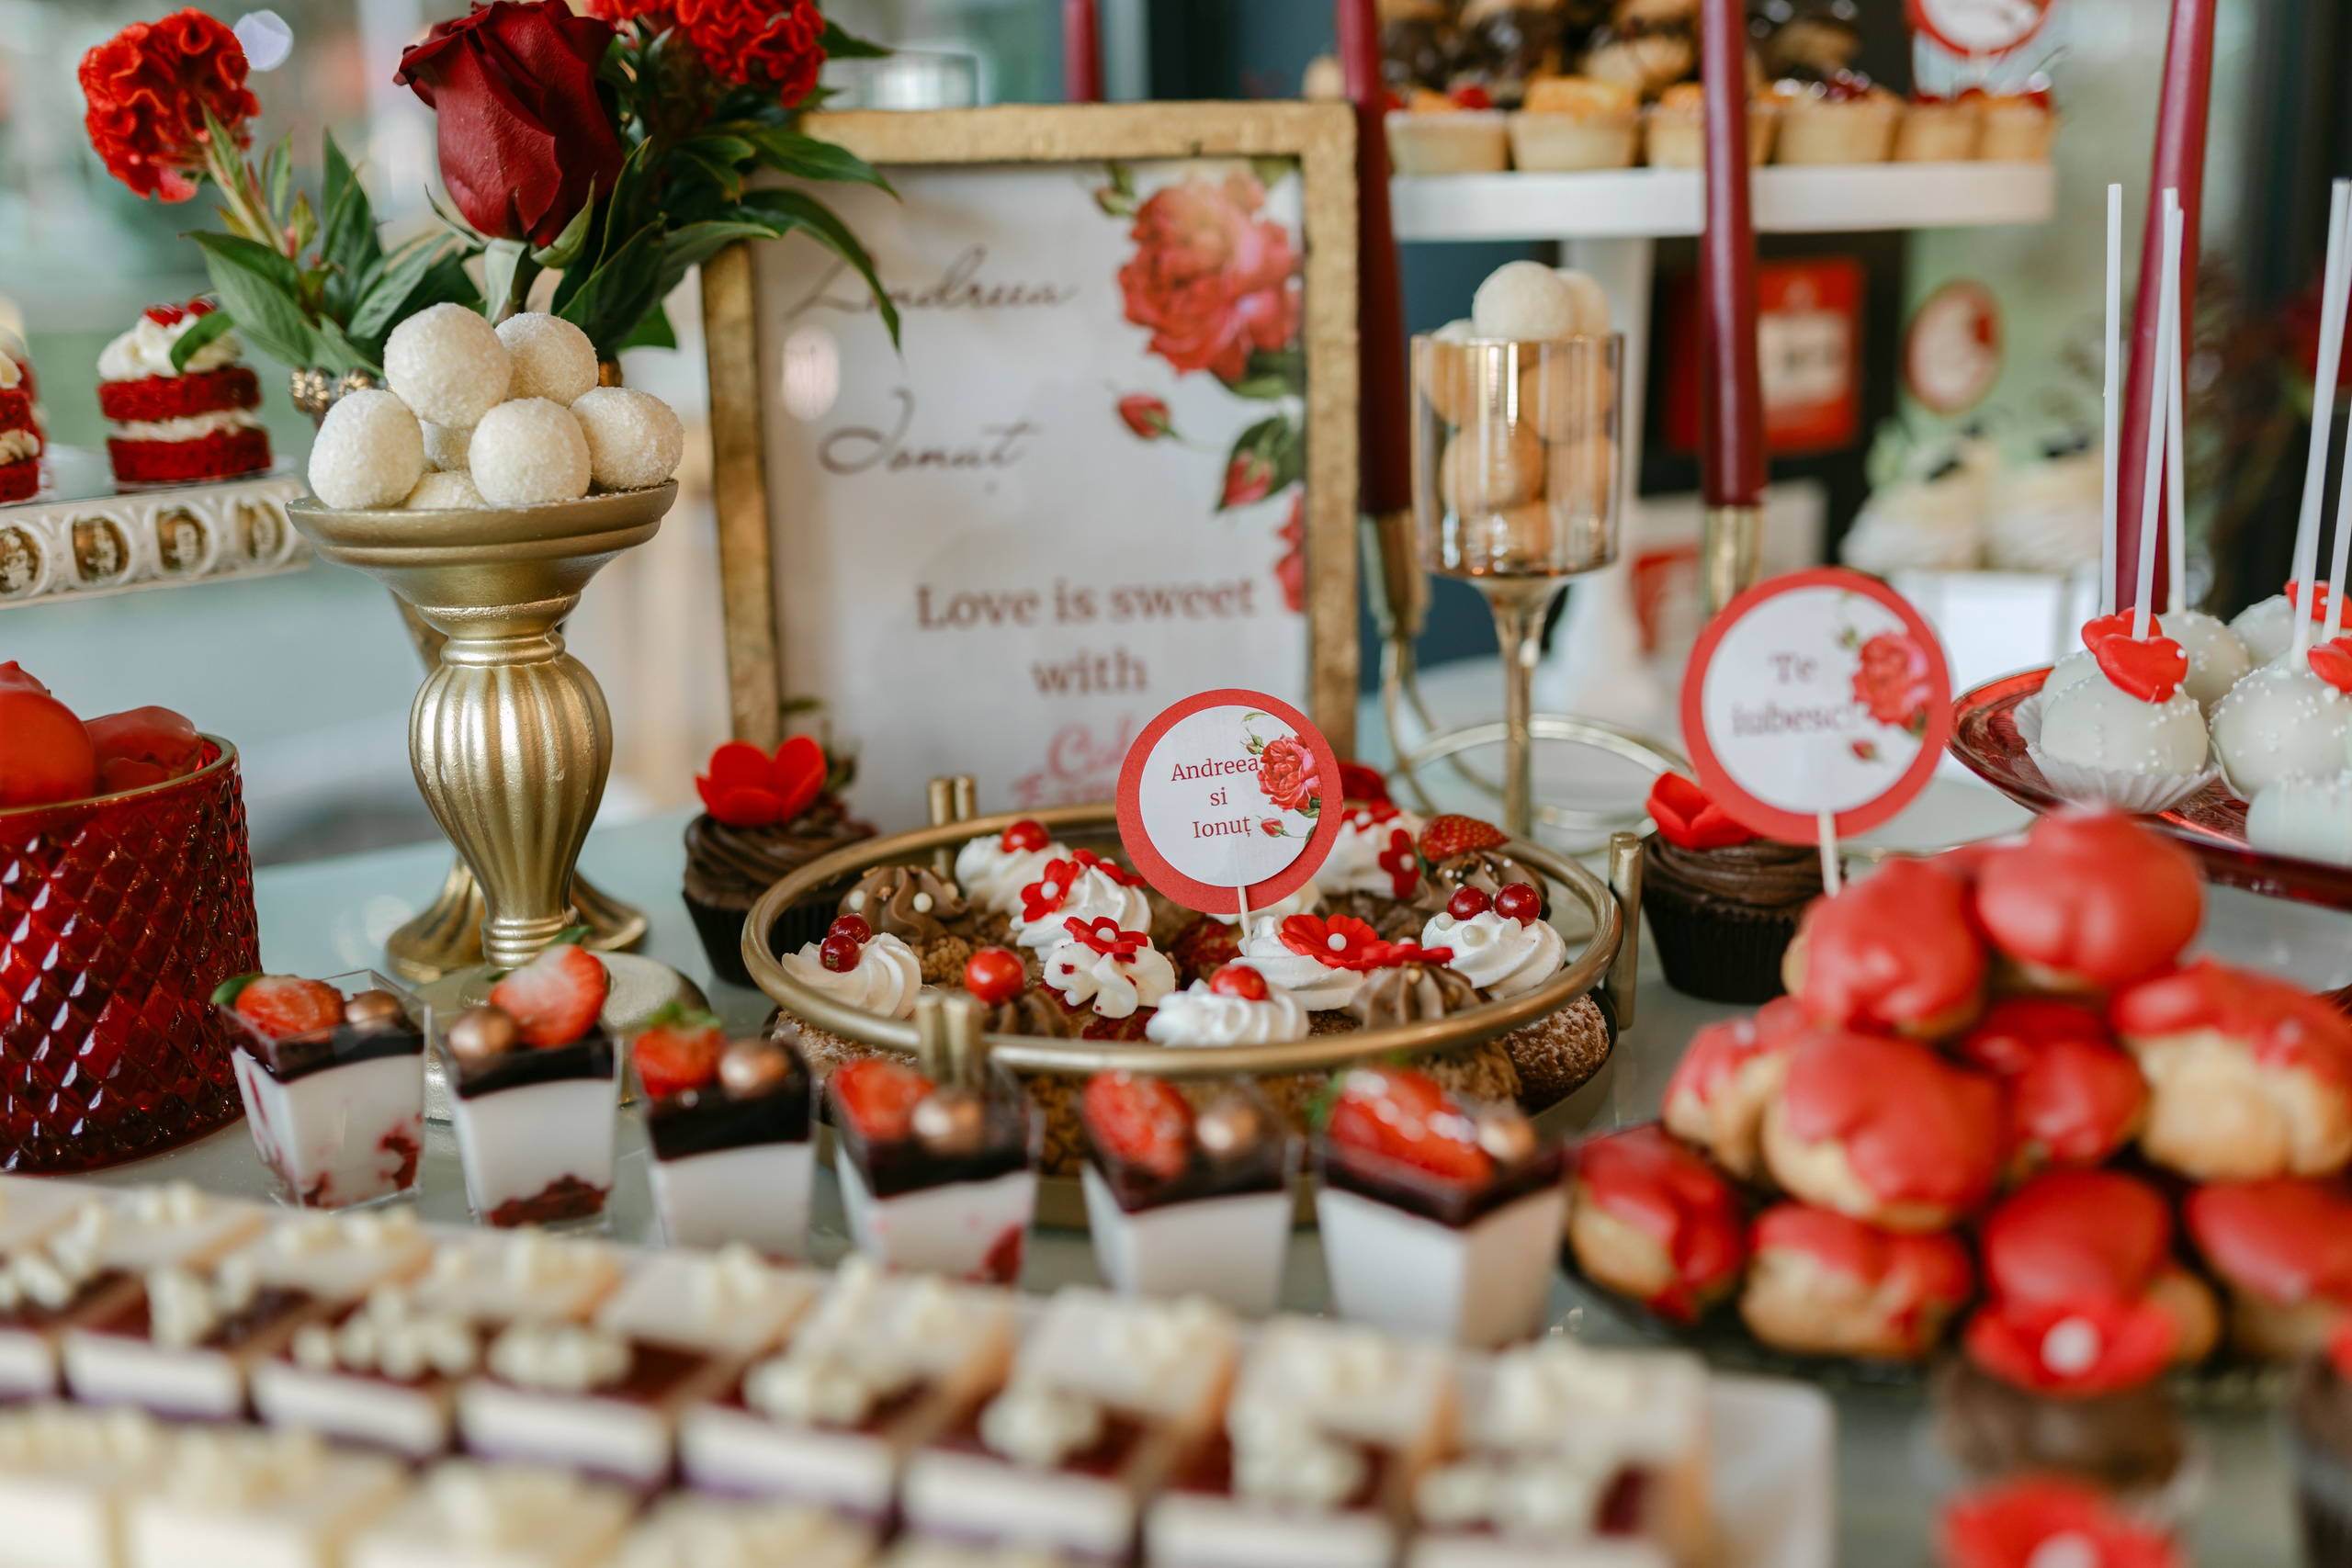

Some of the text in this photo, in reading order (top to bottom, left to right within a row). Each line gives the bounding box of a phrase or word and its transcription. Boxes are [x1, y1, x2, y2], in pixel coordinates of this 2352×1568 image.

[916, 578, 1255, 629] Love is sweet
[1033, 647, 1148, 695] with
[1768, 651, 1817, 684] Te
[1171, 758, 1259, 781] Andreea
[1210, 787, 1227, 806] si
[1193, 817, 1251, 838] Ionuț
